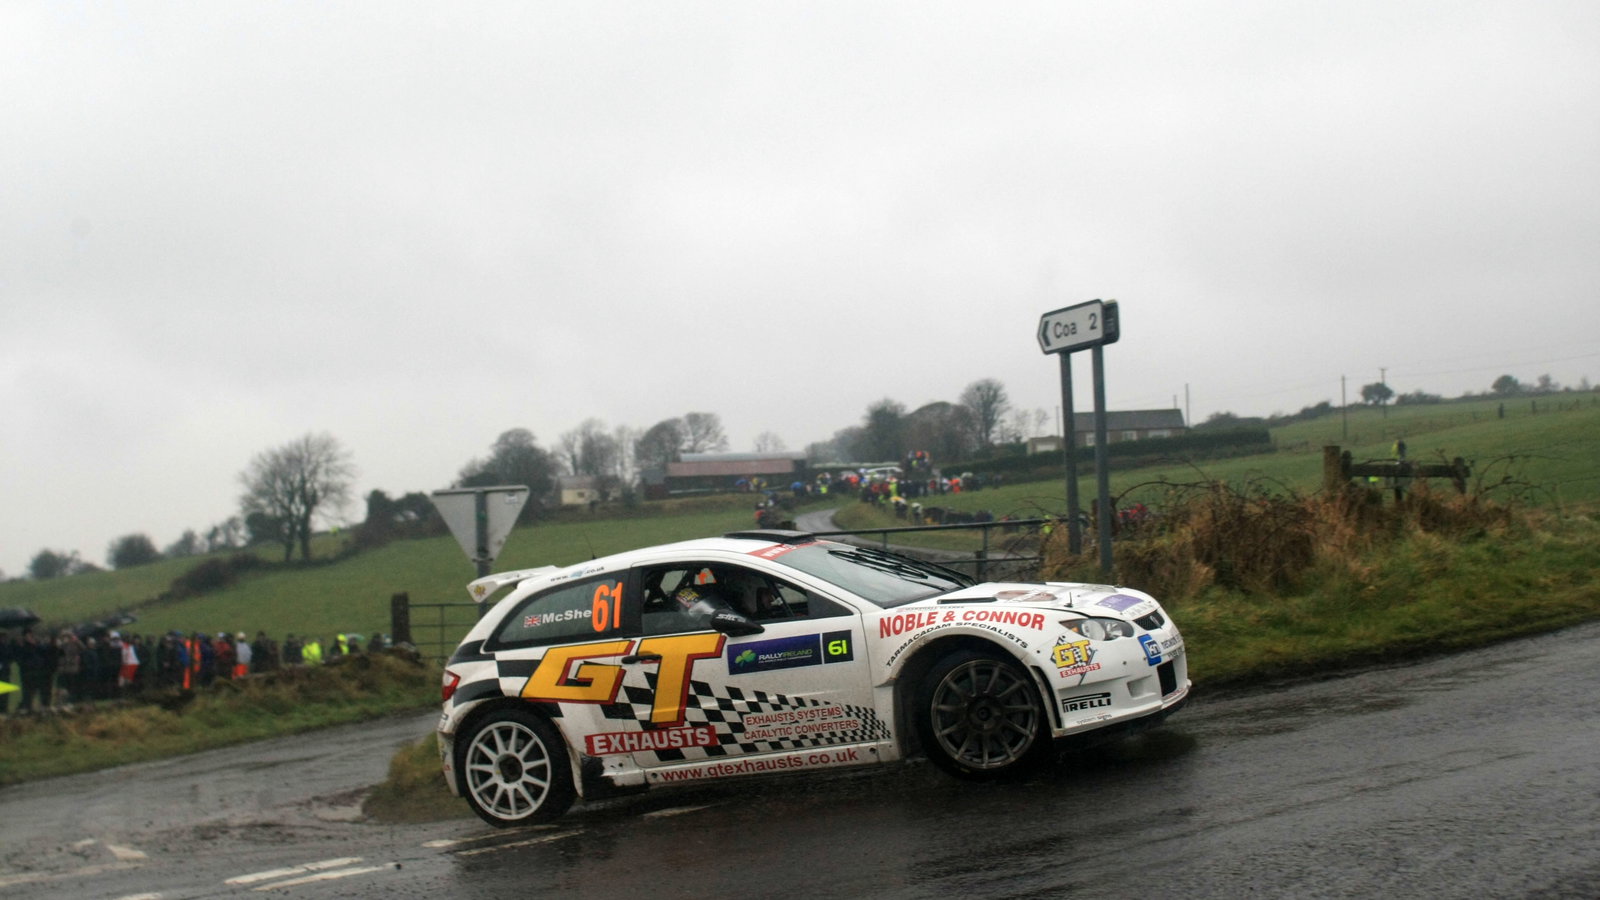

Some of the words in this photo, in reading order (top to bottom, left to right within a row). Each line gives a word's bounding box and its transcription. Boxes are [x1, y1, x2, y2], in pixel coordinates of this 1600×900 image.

[1053, 321, 1077, 339] Coa
[1088, 312, 1098, 331] 2
[542, 609, 593, 624] McShe
[592, 582, 623, 632] 61
[879, 611, 939, 639] NOBLE
[942, 610, 956, 623] &
[962, 610, 1046, 631] CONNOR
[828, 639, 848, 656] 61
[886, 622, 951, 667] TARMACADAM
[955, 621, 1029, 649] SPECIALISTS
[1053, 639, 1091, 669] GT
[520, 632, 727, 728] GT
[1061, 663, 1100, 678] EXHAUSTS
[745, 711, 795, 726] EXHAUSTS
[797, 706, 842, 720] SYSTEMS
[1061, 692, 1112, 713] PIRELLI
[592, 728, 711, 755] EXHAUSTS
[743, 726, 793, 740] CATALYTIC
[795, 720, 859, 735] CONVERTERS
[660, 748, 860, 780] www.gtexhausts.co.uk
